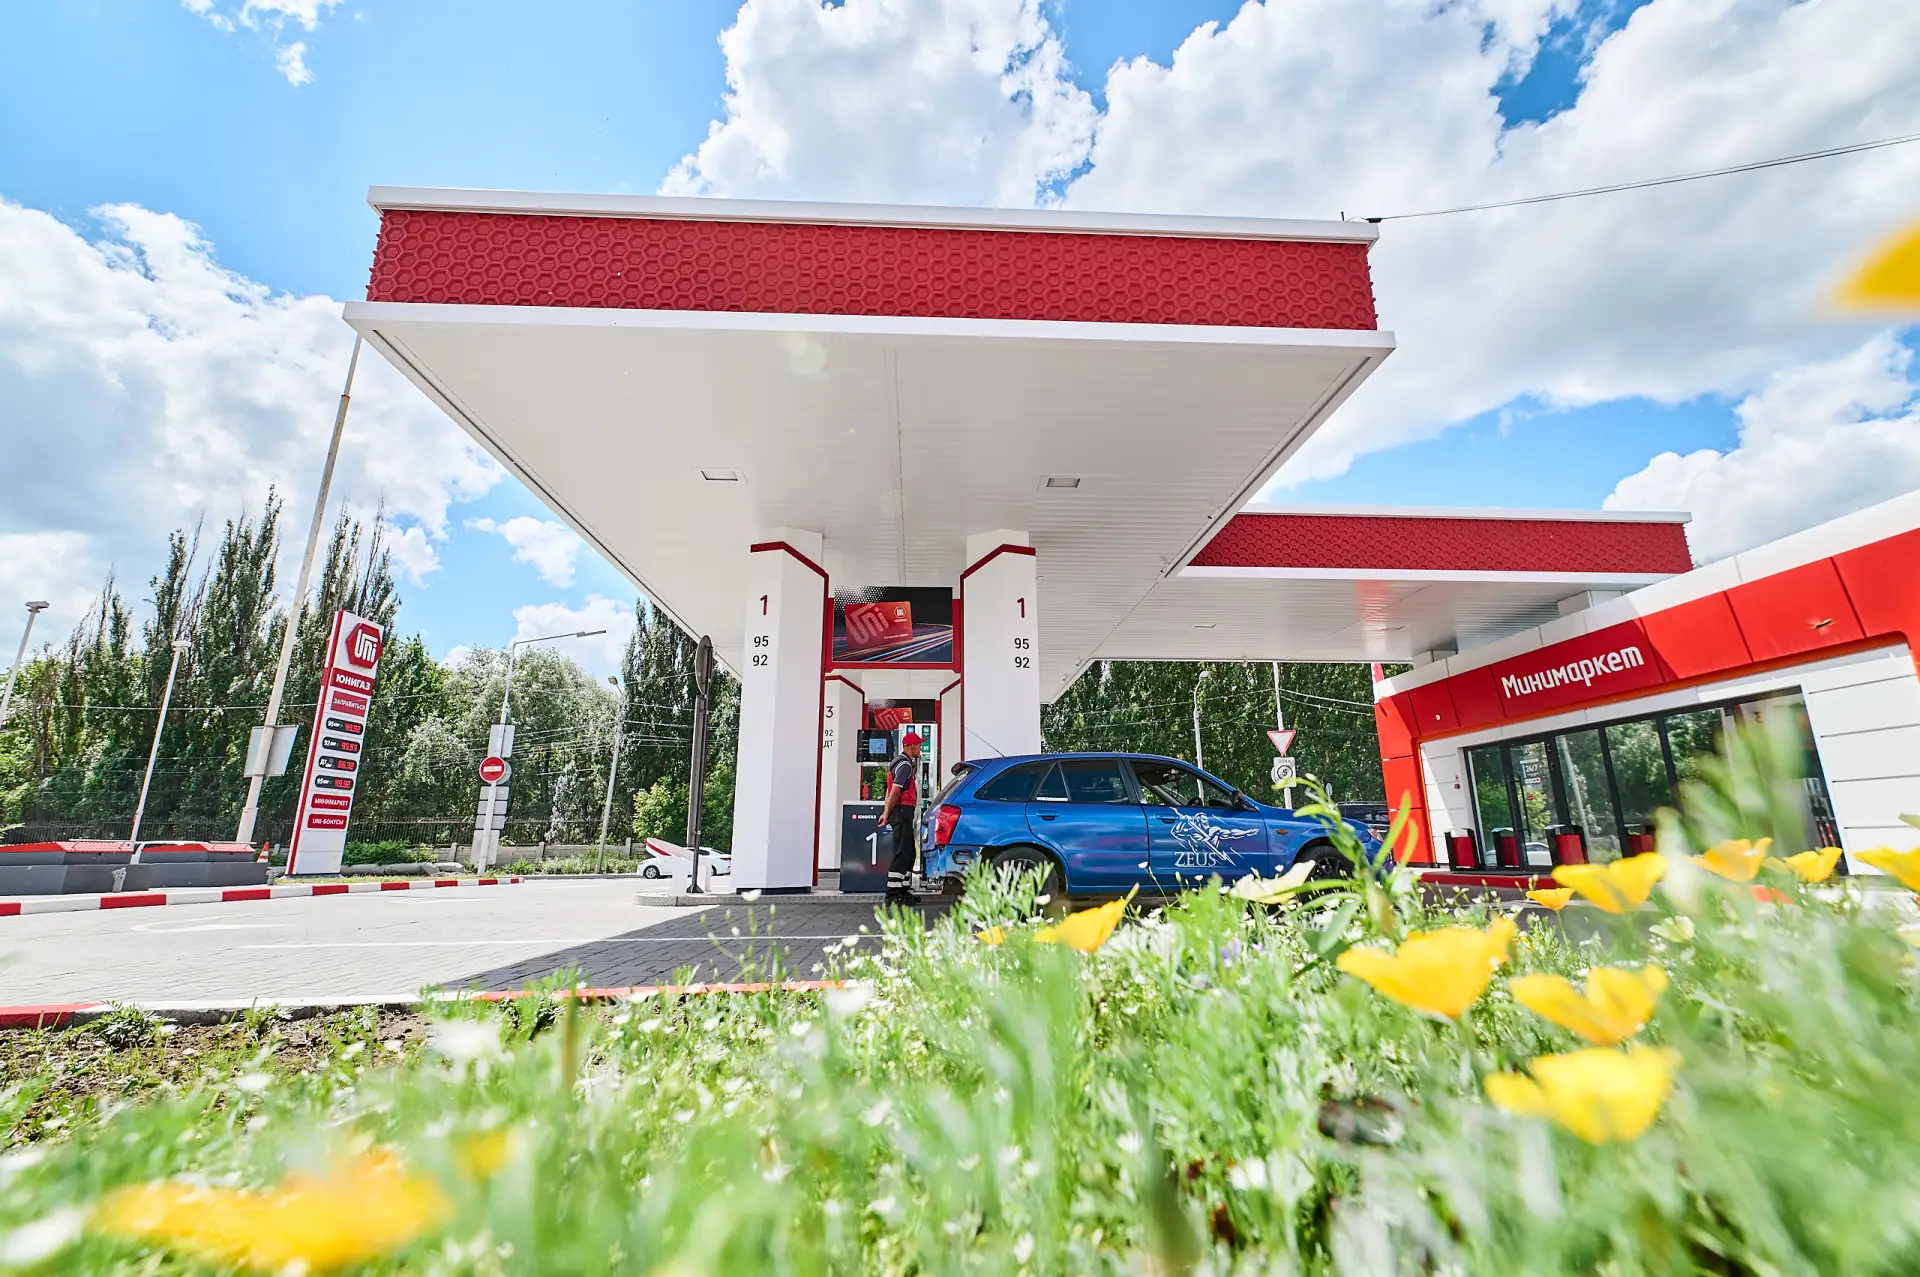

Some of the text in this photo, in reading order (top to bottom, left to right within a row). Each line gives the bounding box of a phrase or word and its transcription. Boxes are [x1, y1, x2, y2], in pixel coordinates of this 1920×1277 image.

[760, 595, 768, 615] 1
[1017, 597, 1025, 618] 1
[754, 636, 769, 647] 95
[1014, 637, 1030, 650] 95
[752, 655, 768, 667] 92
[1014, 656, 1030, 668] 92
[1501, 646, 1645, 699] Минимаркет
[336, 673, 371, 690] ЮНИГАЗ
[825, 705, 834, 718] 3
[824, 729, 834, 737] 92
[823, 739, 834, 749] ДТ
[865, 832, 878, 865] 1
[1174, 851, 1217, 868] ZEUS
